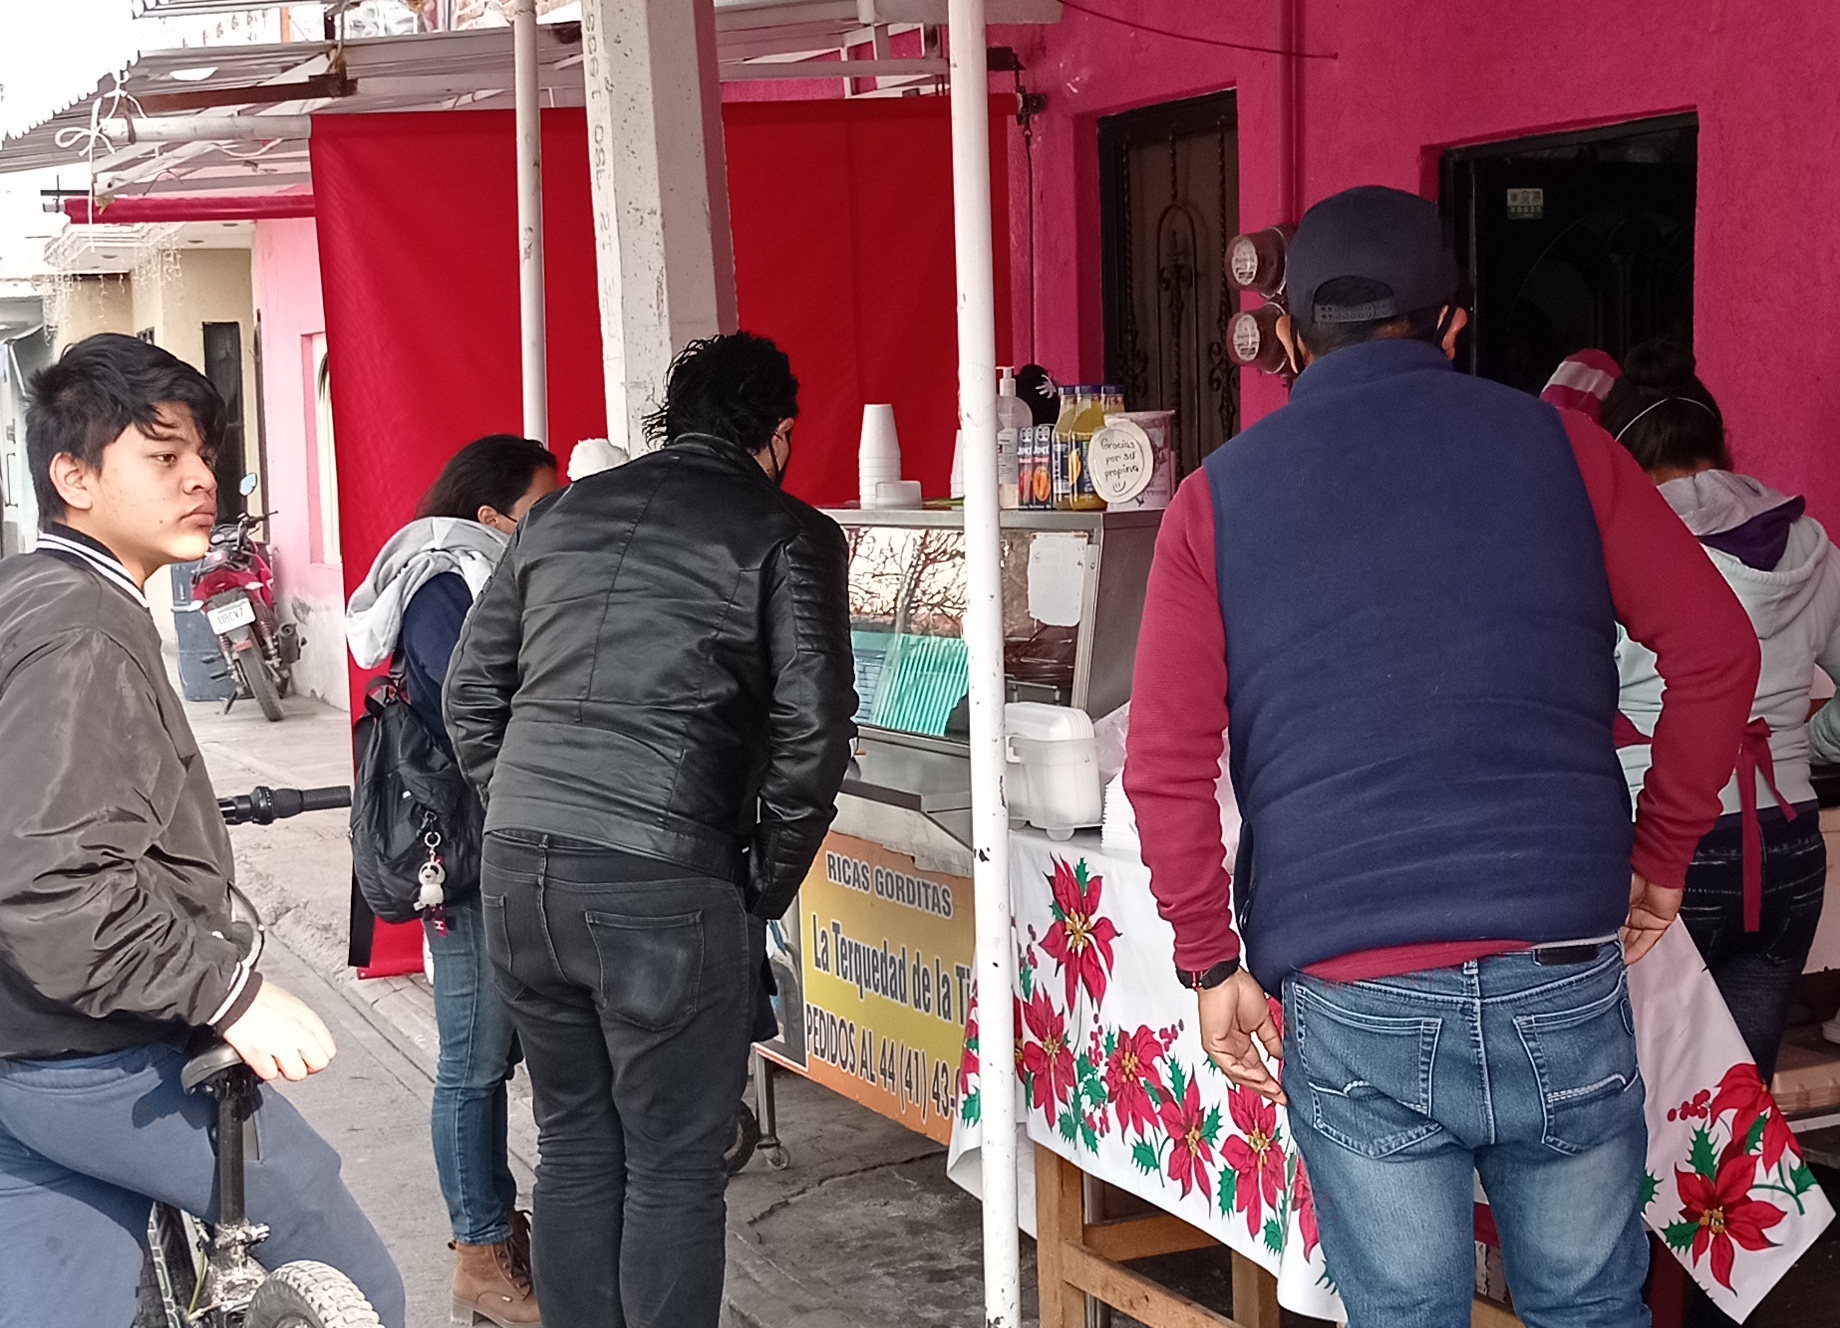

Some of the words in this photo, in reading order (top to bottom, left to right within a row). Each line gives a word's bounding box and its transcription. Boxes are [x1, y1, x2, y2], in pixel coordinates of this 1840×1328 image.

[1100, 437, 1135, 450] Gracias
[1105, 454, 1121, 466] por
[1104, 464, 1139, 482] propina
[827, 853, 870, 892] RICAS
[875, 868, 952, 917] GORDITAS
[812, 915, 829, 972] La
[832, 922, 907, 1004] Terquedad
[912, 952, 931, 1013] de
[936, 958, 952, 1021] la
[955, 964, 971, 1026] Ti
[806, 1004, 856, 1075] PEDIDOS
[861, 1029, 876, 1087] AL
[879, 1038, 895, 1093] 44
[900, 1042, 927, 1120] (41)
